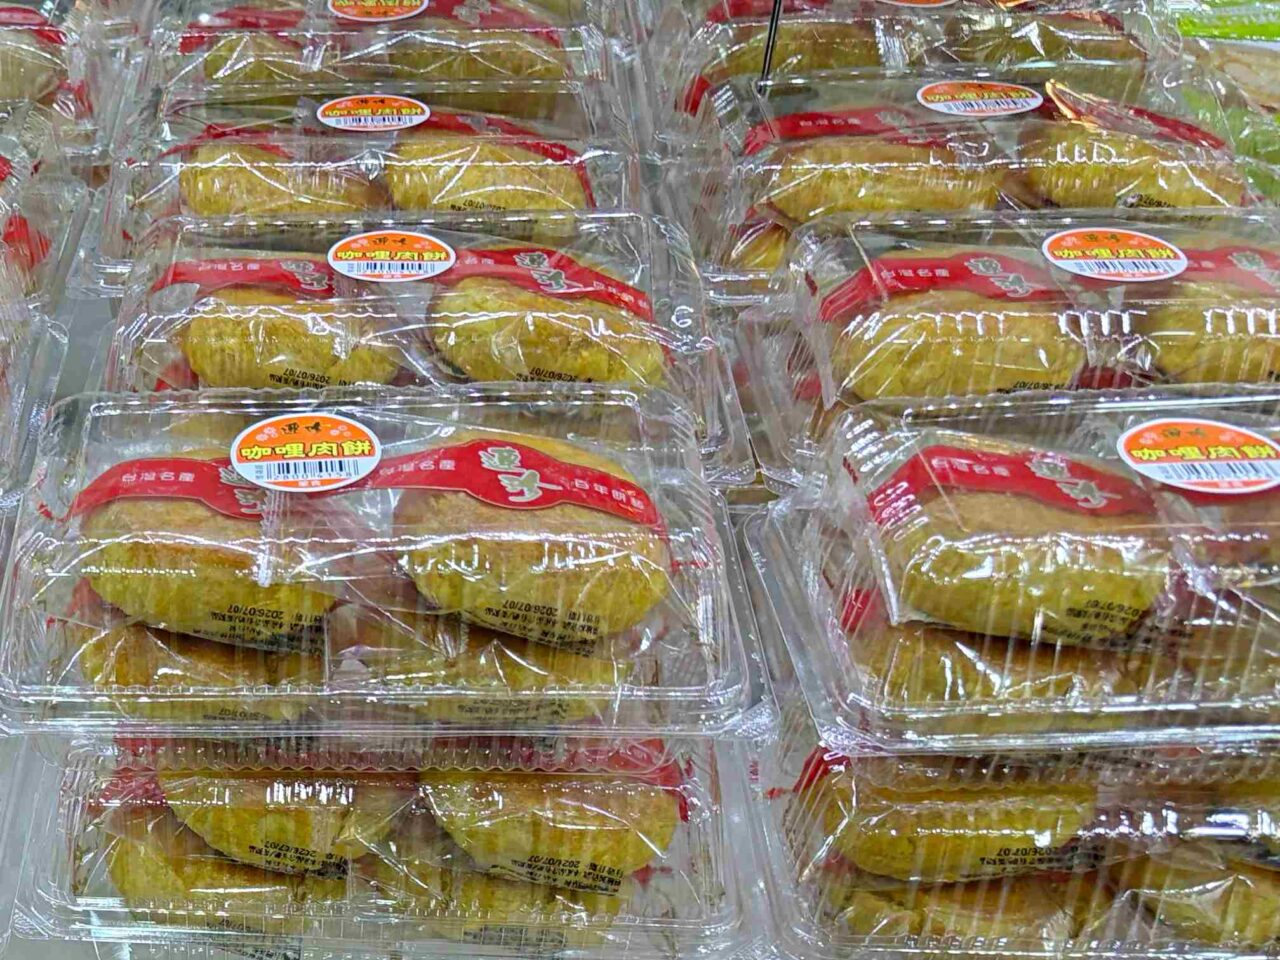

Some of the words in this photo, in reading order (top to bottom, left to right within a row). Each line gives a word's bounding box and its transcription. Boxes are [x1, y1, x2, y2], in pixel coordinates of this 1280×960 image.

[336, 250, 447, 261] 咖哩肉餅
[240, 440, 372, 459] 咖哩肉餅
[1130, 444, 1277, 461] 咖哩肉餅
[227, 604, 284, 619] 2026/07/07
[502, 599, 558, 617] 2026/07/07
